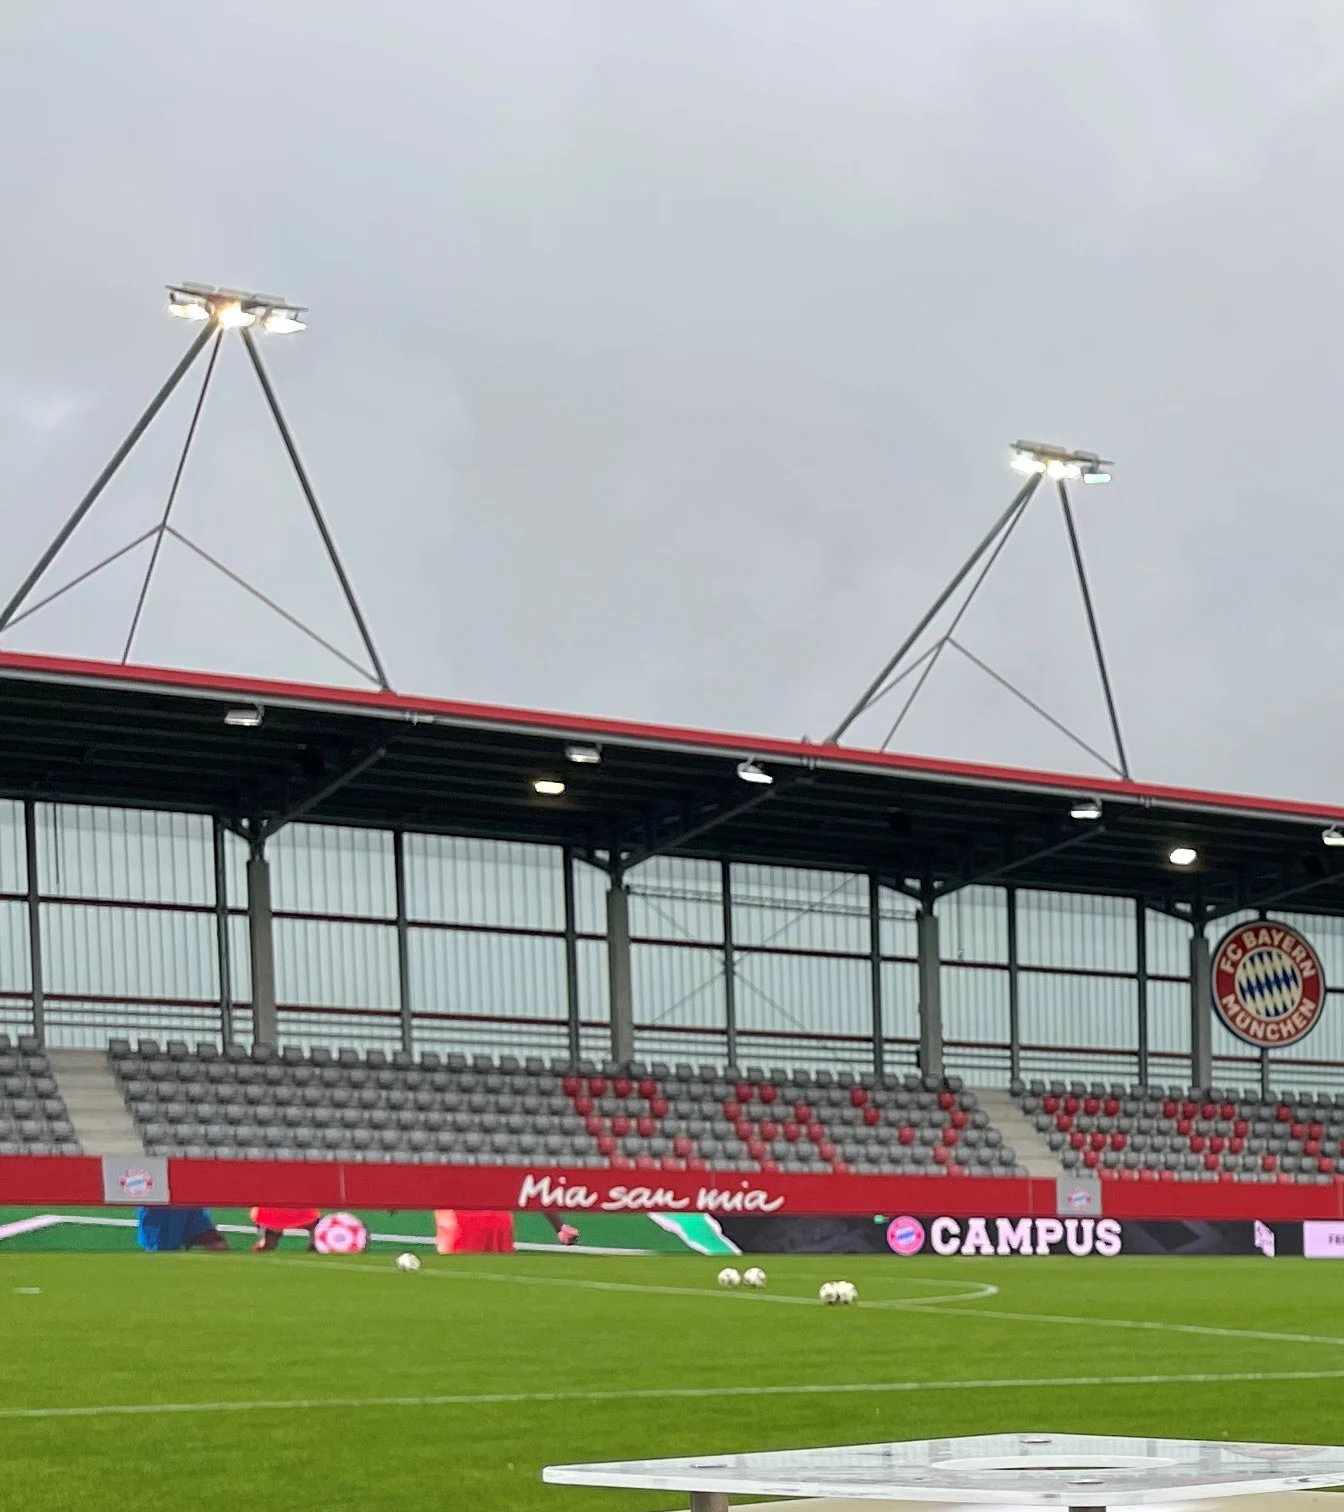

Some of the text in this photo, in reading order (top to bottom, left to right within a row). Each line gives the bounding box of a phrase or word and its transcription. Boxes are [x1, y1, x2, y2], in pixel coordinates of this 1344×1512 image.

[1220, 928, 1316, 978] FC BAYERN
[518, 1174, 784, 1212] Mia san mia
[930, 1216, 1122, 1256] CAMPUS
